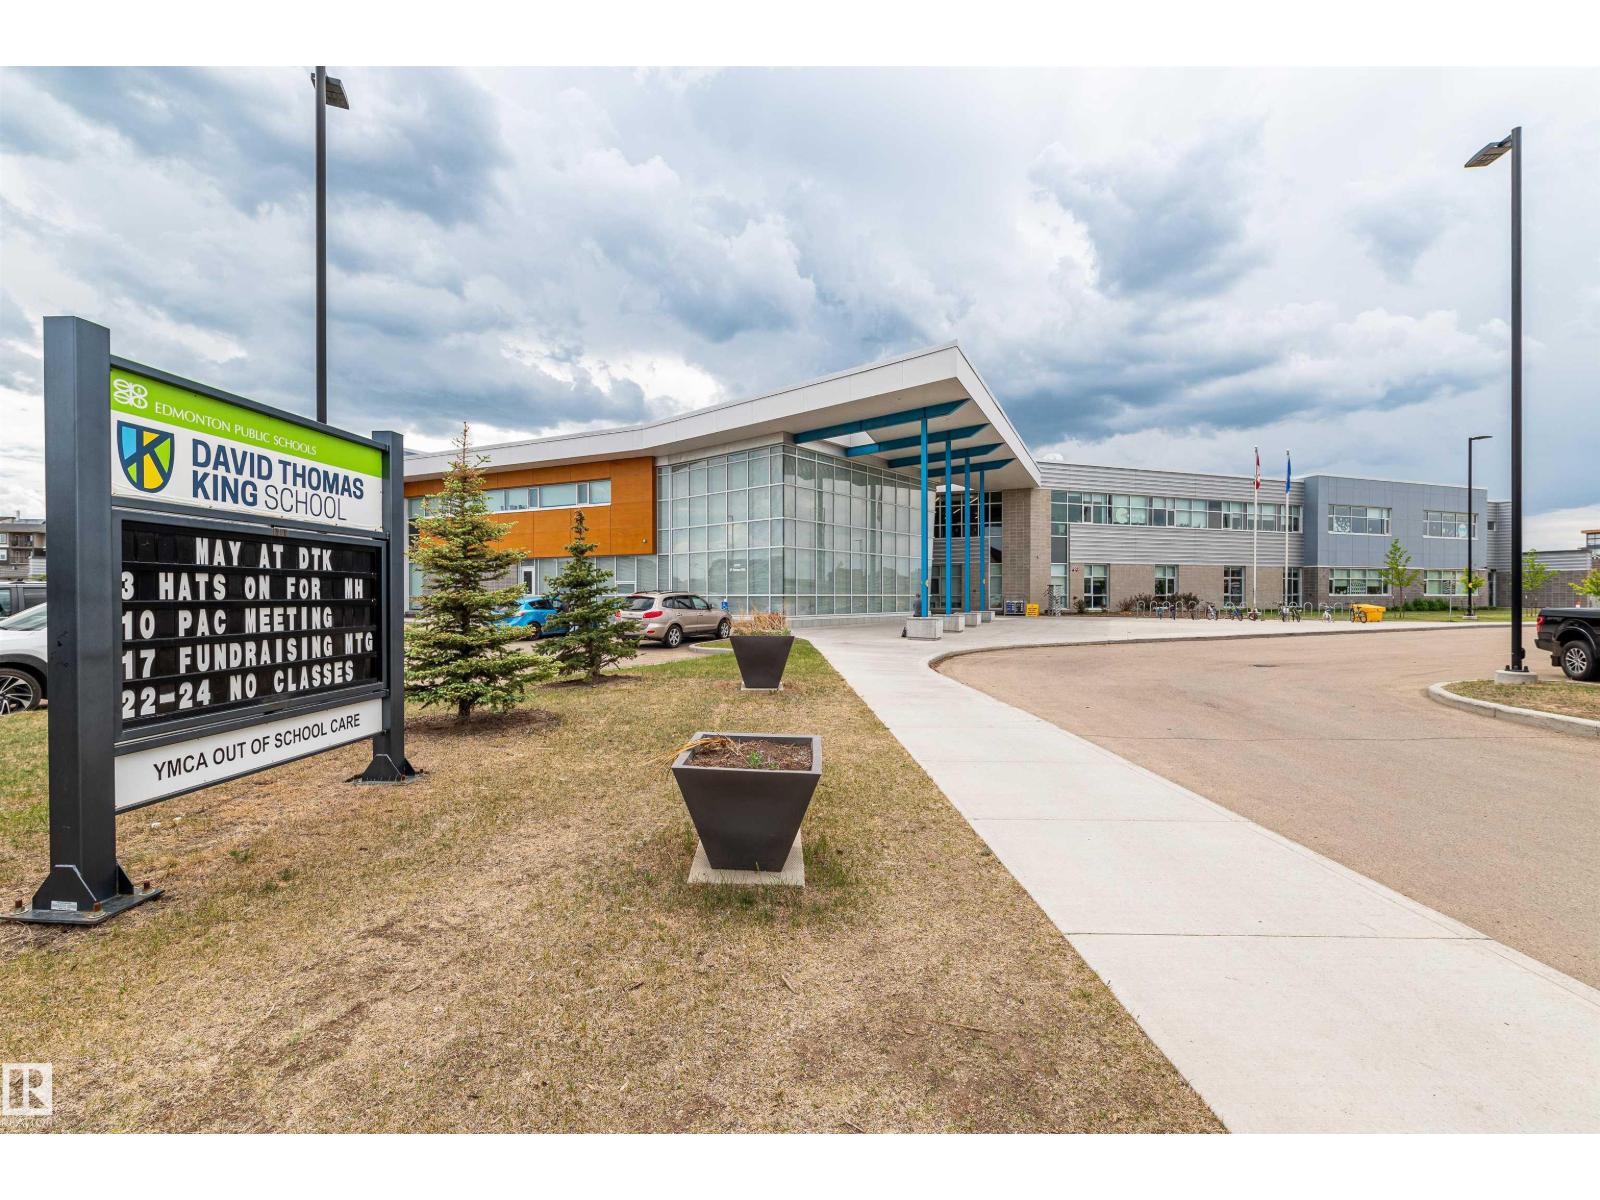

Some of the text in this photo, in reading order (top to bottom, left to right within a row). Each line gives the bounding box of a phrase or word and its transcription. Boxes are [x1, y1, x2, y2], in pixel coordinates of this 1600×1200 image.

[155, 401, 317, 456] EDMONTON PUBLIC SCHOOLS
[192, 438, 364, 500] DAVID THOMAS
[192, 470, 347, 520] KING SCHOOL
[195, 537, 332, 571] MAY AT DTK
[121, 571, 363, 601] 3 HATS ON FOR MH
[121, 606, 333, 640] 10 PAC MEETING
[121, 631, 373, 680] 17 FUNDRAISING MTG
[121, 660, 354, 720] 22-24 NO CLASSES
[153, 713, 360, 781] YMCA OUT OF SCHOOL CARE
